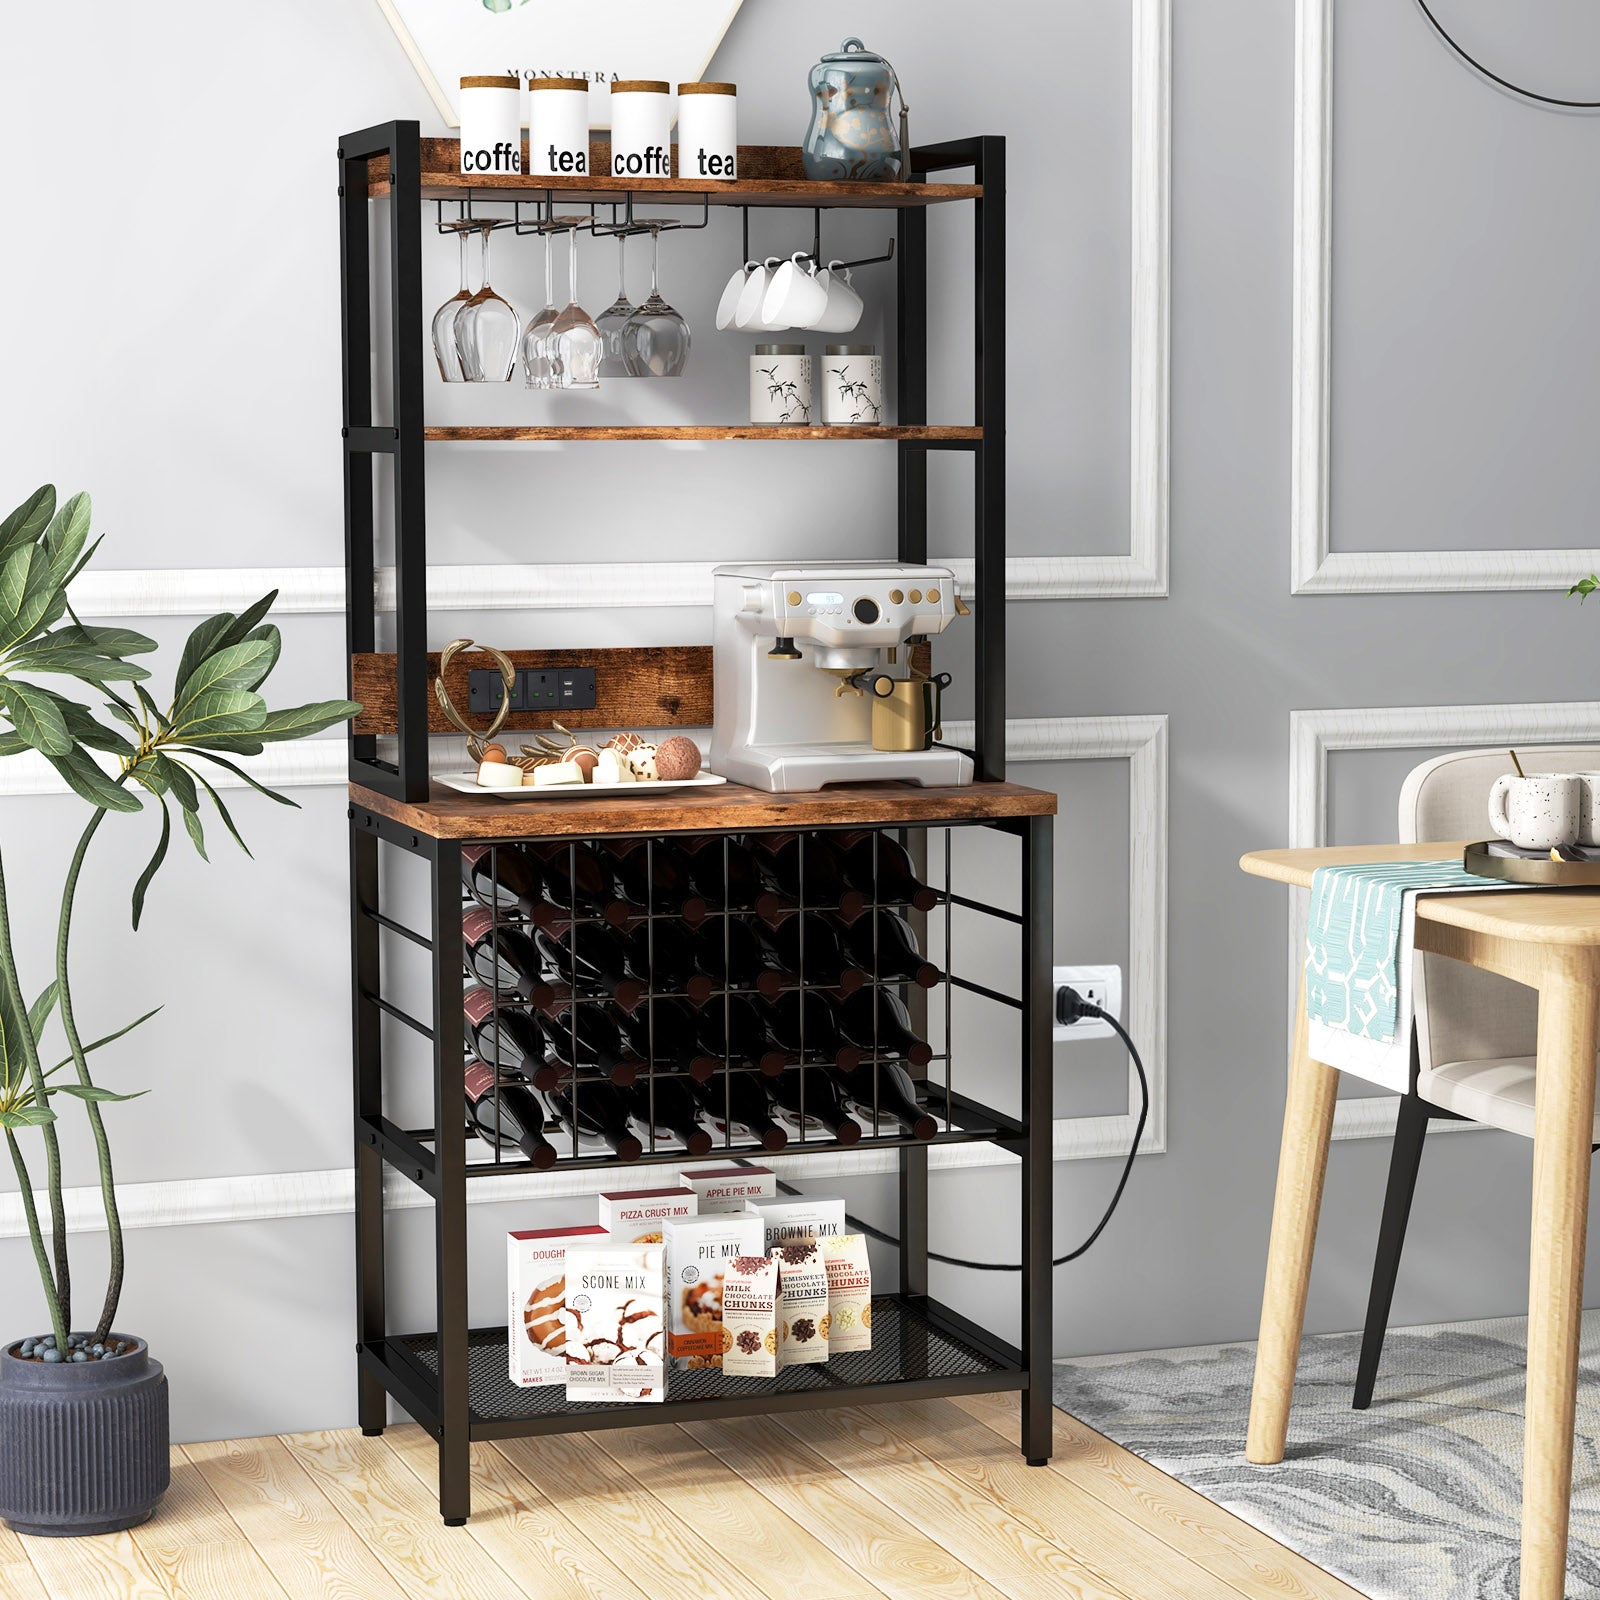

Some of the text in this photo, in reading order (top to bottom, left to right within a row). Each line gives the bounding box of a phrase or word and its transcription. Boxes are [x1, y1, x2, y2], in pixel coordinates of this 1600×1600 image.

[507, 69, 620, 83] MONSTERA
[463, 143, 520, 172] coffe
[548, 145, 586, 173] tea
[614, 146, 670, 175] coffe
[698, 148, 735, 176] tea
[706, 1185, 762, 1198] APPLE PIE MIX
[620, 1206, 689, 1220] PIZZA CRUST MIX
[766, 1223, 838, 1241] BROWNIE MIX
[698, 1243, 740, 1259] PIE MIX
[825, 1263, 854, 1272] WHITE
[827, 1270, 869, 1279] HOCOLATE
[582, 1275, 646, 1289] SCONE MIX
[782, 1274, 825, 1283] EMISWEET
[724, 1292, 773, 1300] CHOCOLATE
[724, 1300, 773, 1309] CHUNKS
[522, 1376, 543, 1384] MAKES
